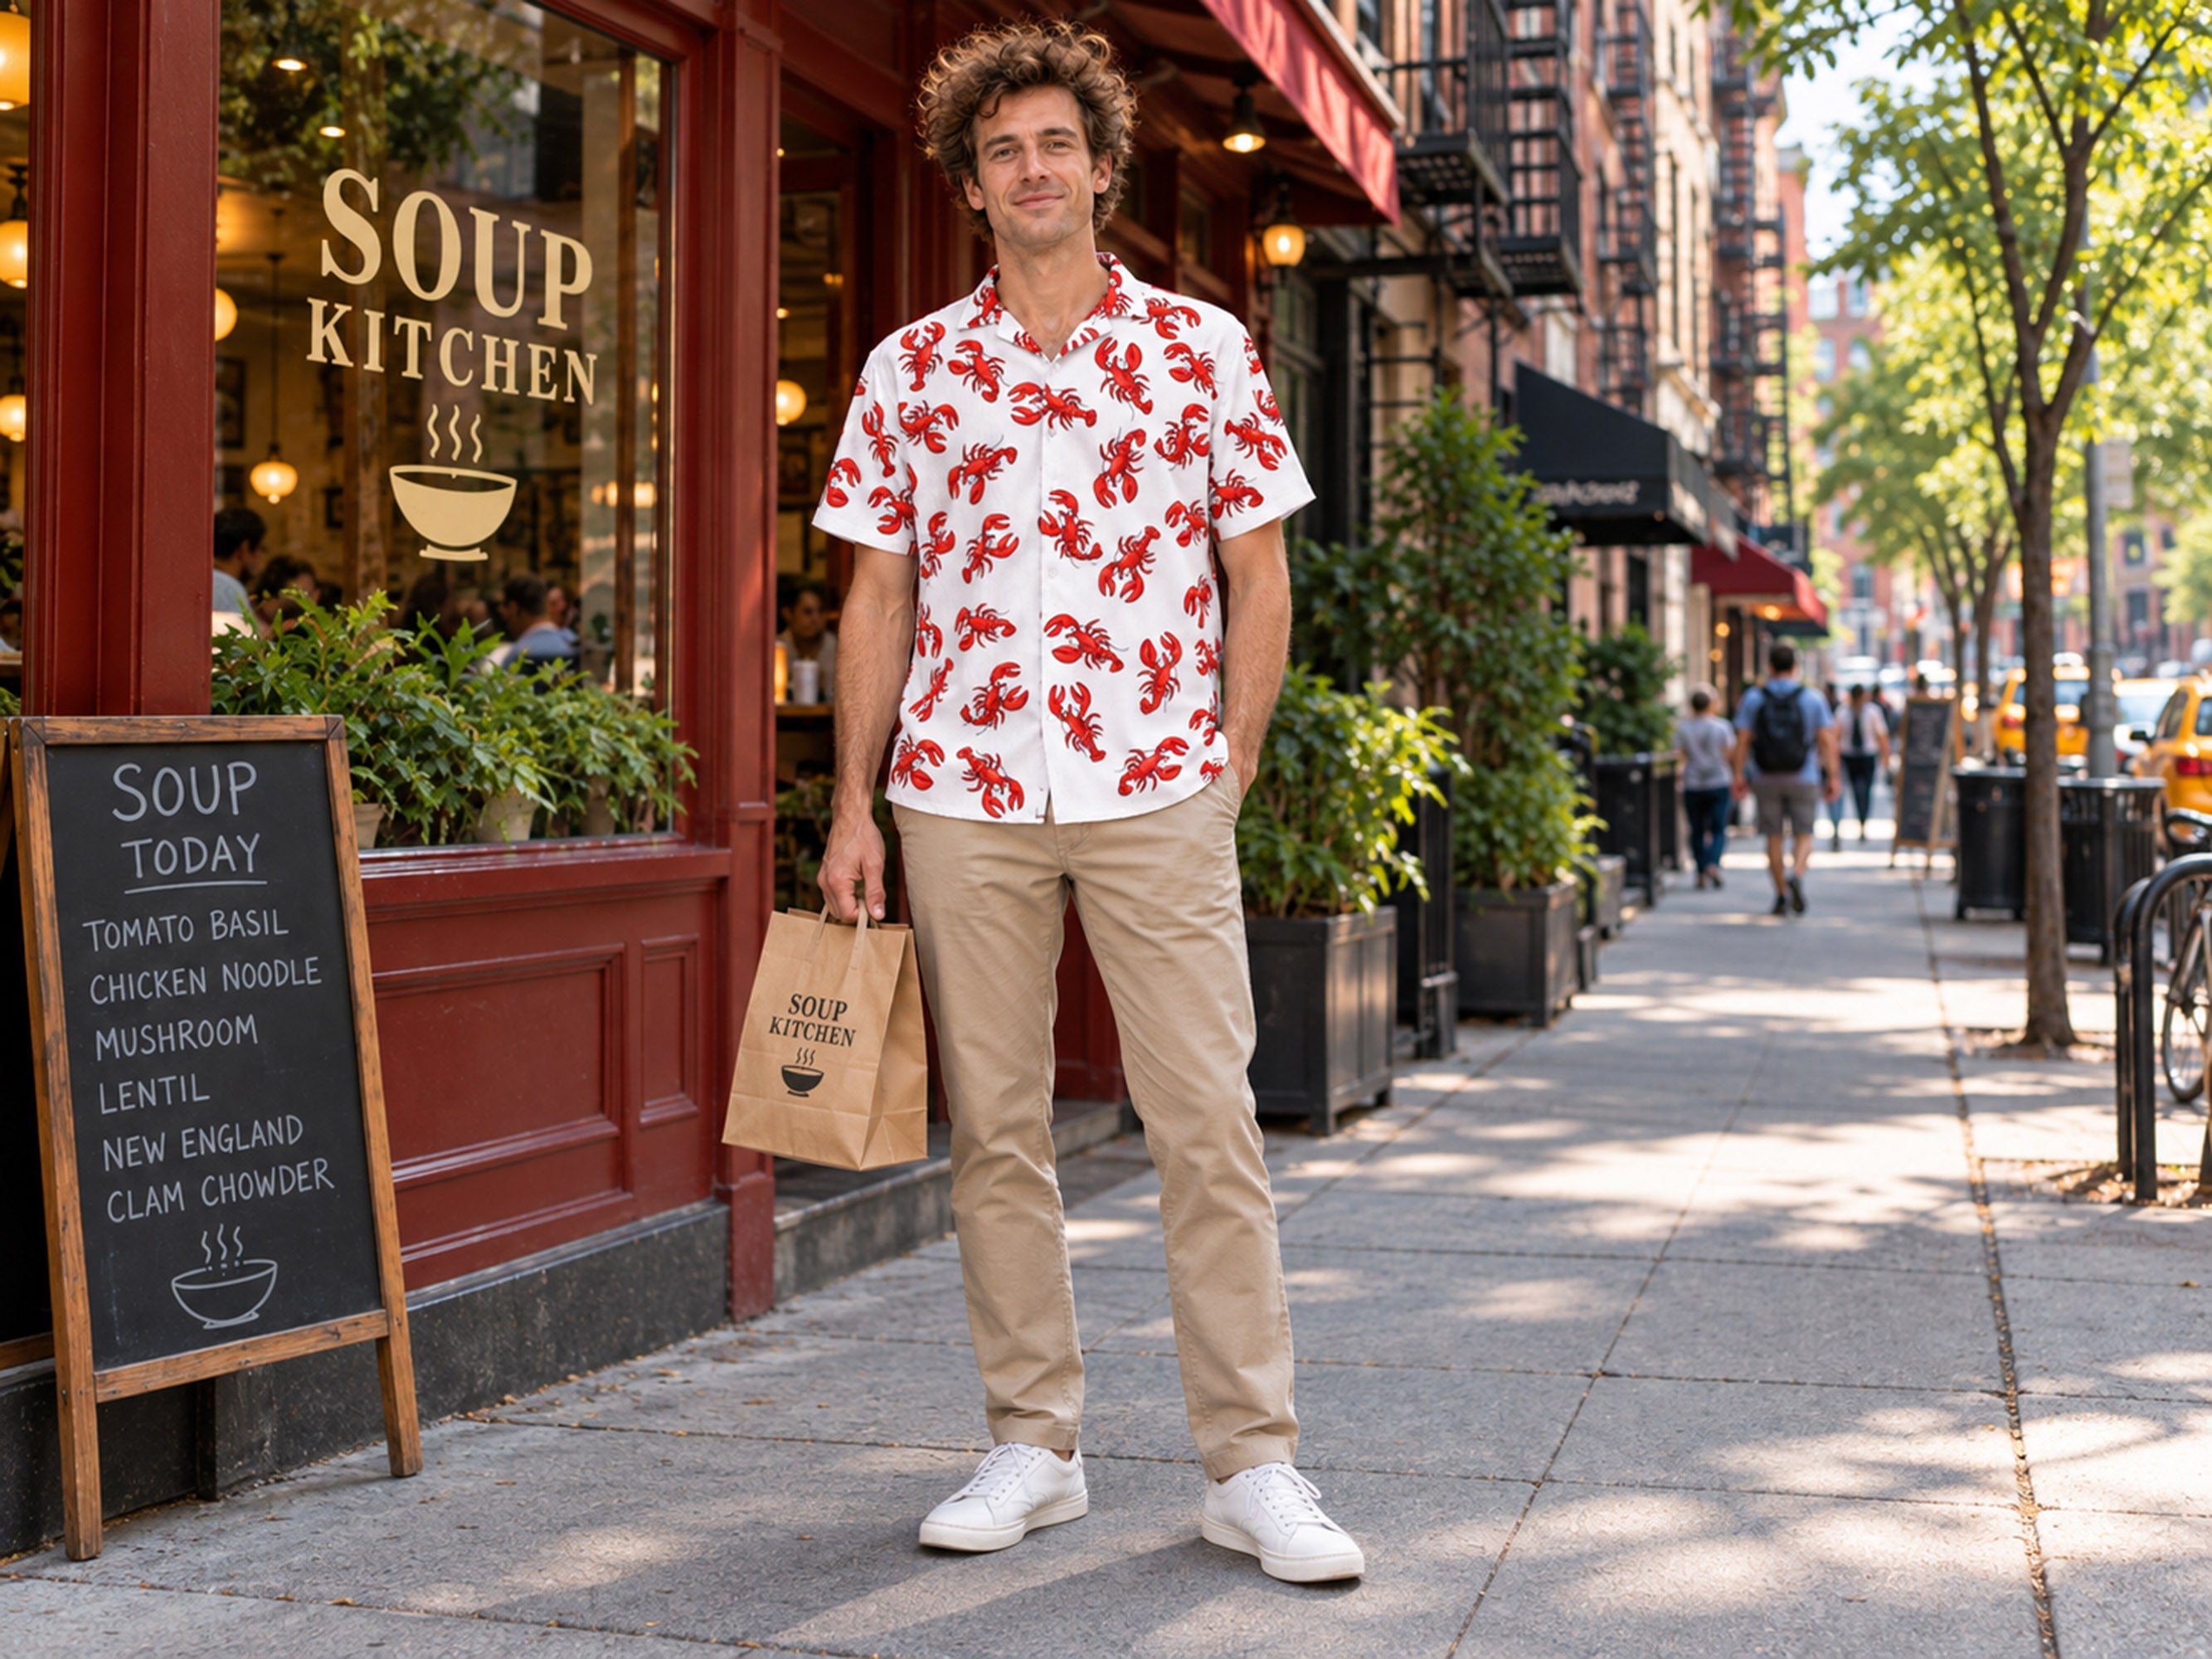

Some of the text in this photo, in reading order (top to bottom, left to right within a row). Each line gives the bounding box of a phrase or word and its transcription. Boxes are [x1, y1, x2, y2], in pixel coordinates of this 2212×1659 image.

[321, 168, 593, 330] SOUP
[307, 297, 598, 405] KITCHEN
[112, 761, 258, 822] SOUP
[121, 833, 261, 878] TODAY
[82, 908, 289, 953] TOMATO BASIL
[90, 956, 323, 1005] CHICKEN NOODLE
[789, 994, 847, 1021] SOUP
[95, 1014, 259, 1062] MUSHROOM
[770, 1017, 855, 1047] KITCHEN
[99, 1073, 211, 1114] LENTIL
[103, 1115, 304, 1171] NEW ENGLAND
[107, 1157, 335, 1224] CLAM CHOWDER
